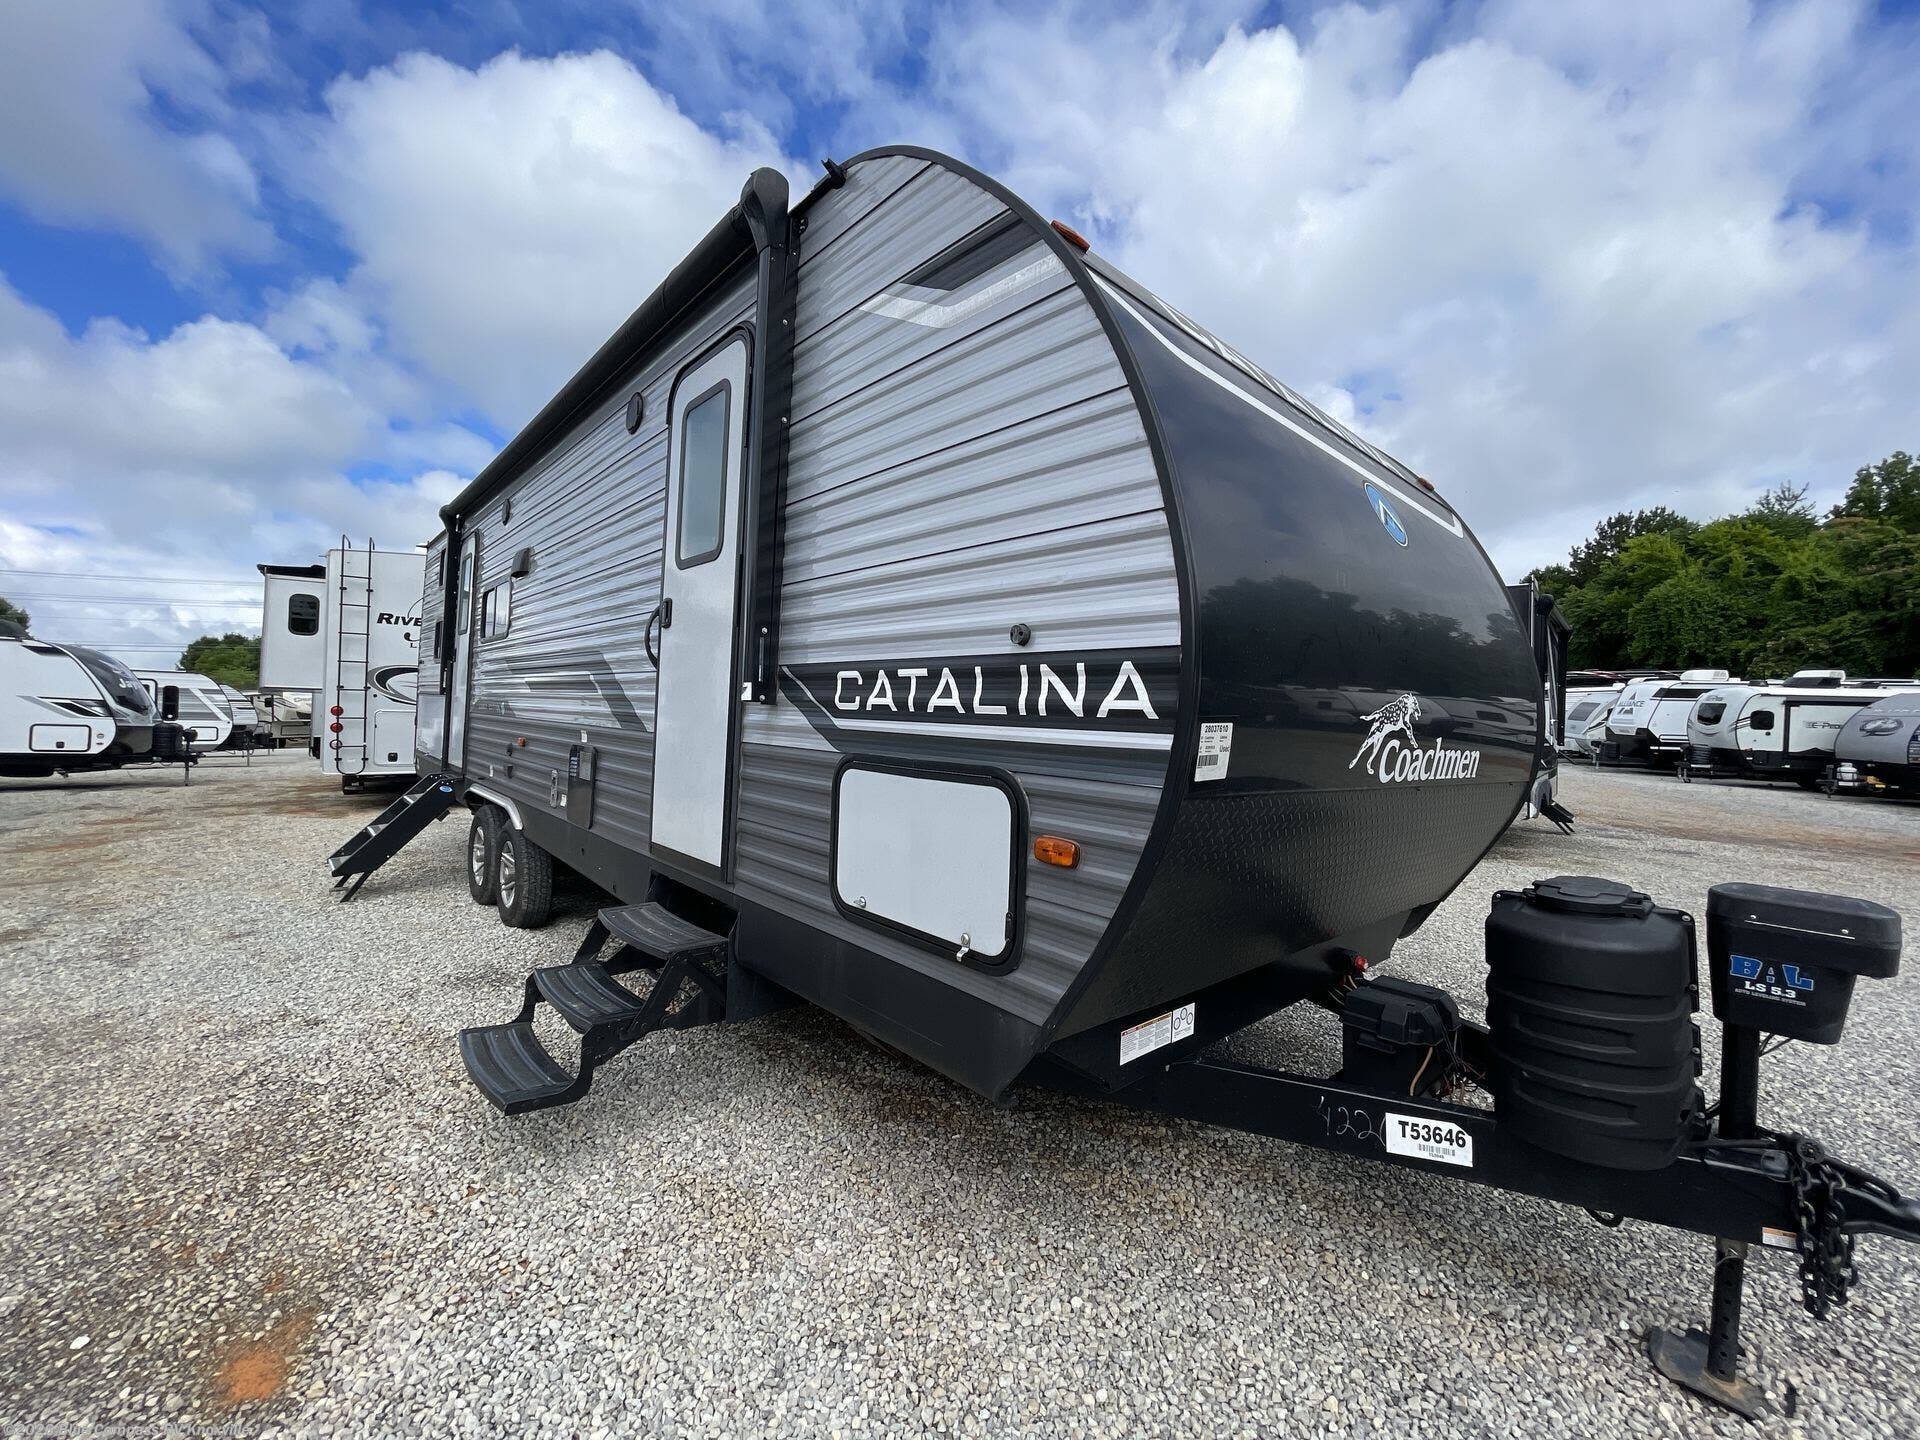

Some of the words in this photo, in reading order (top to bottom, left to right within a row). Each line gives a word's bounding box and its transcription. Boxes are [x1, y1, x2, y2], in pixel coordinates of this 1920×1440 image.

[834, 660, 1160, 720] CATALINA
[1379, 737, 1480, 783] Coachmen
[1729, 954, 1814, 991] BAL
[1398, 1120, 1467, 1149] T53646
